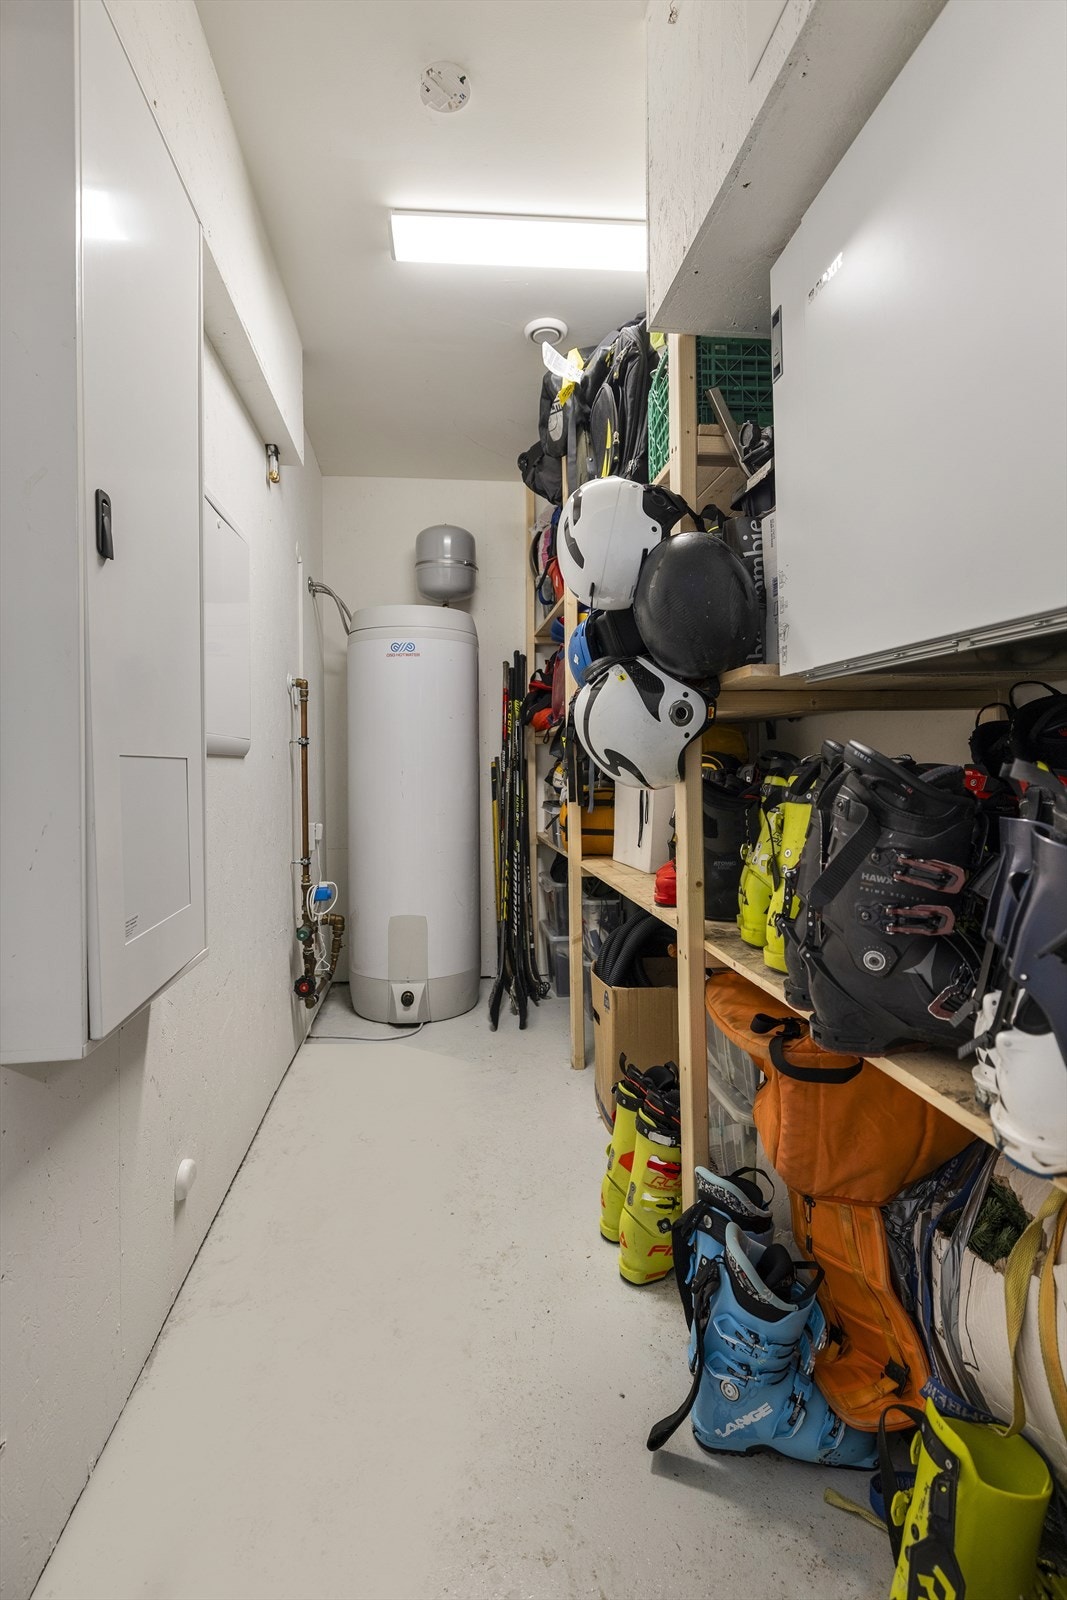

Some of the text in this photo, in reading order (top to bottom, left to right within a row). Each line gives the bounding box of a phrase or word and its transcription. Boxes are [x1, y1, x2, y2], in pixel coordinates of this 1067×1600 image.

[861, 872, 893, 885] HAWX
[647, 1245, 672, 1256] FI
[715, 1402, 773, 1437] LANGE
